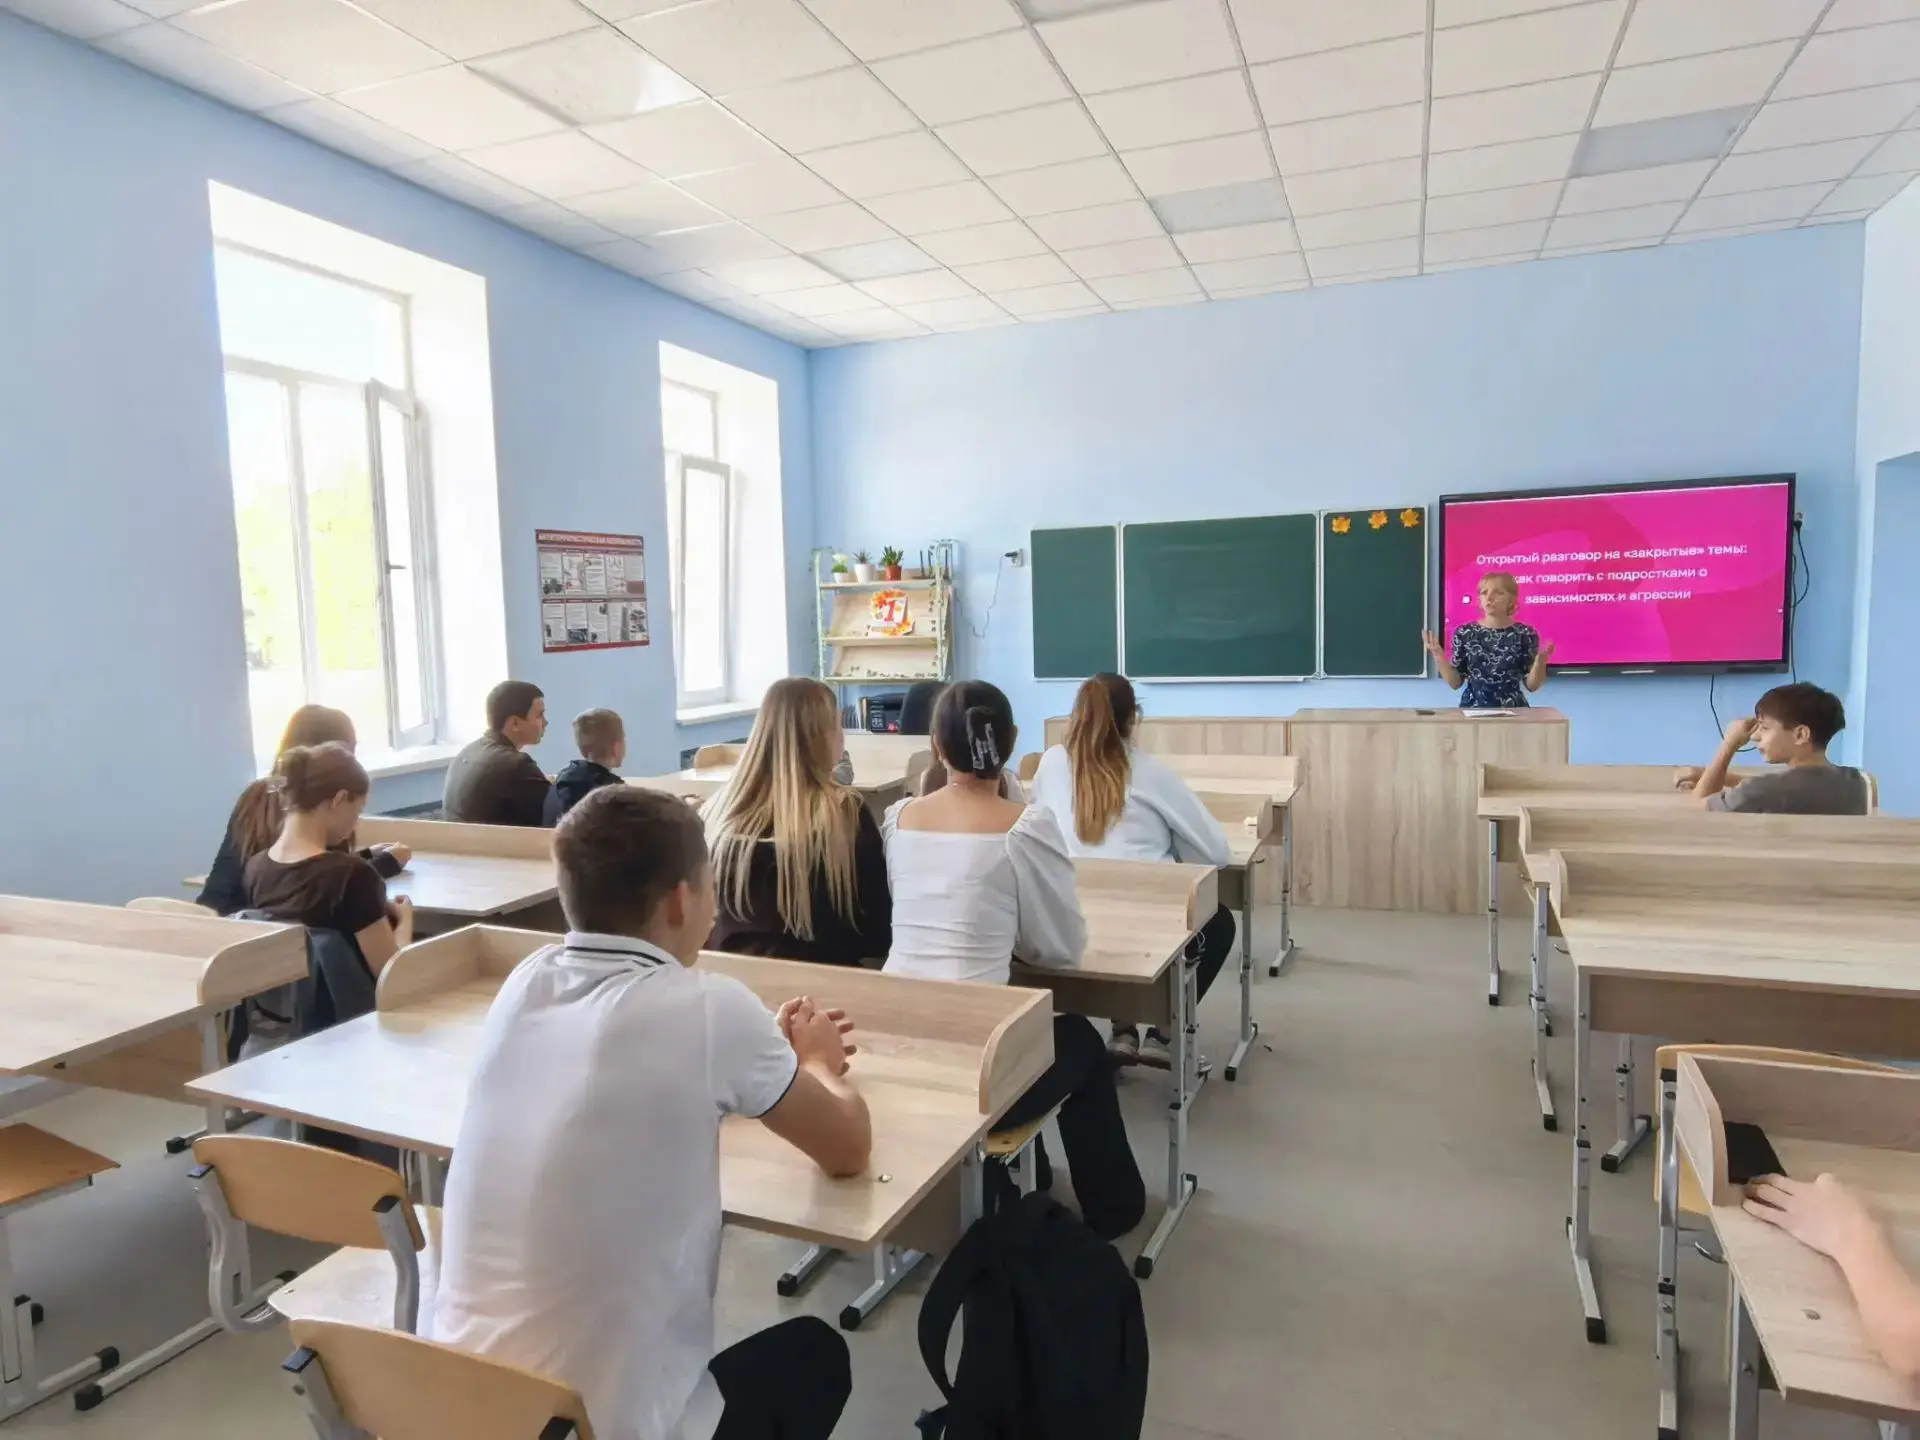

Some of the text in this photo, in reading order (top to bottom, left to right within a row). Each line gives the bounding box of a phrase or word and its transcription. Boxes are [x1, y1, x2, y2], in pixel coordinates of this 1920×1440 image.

[1476, 544, 1748, 566] Открытый разговор на «закрытые» темы:
[1536, 574, 1594, 584] говорить
[1608, 568, 1696, 581] подростками
[1699, 568, 1708, 577] о
[1525, 591, 1692, 604] зависимостях и агрессии
